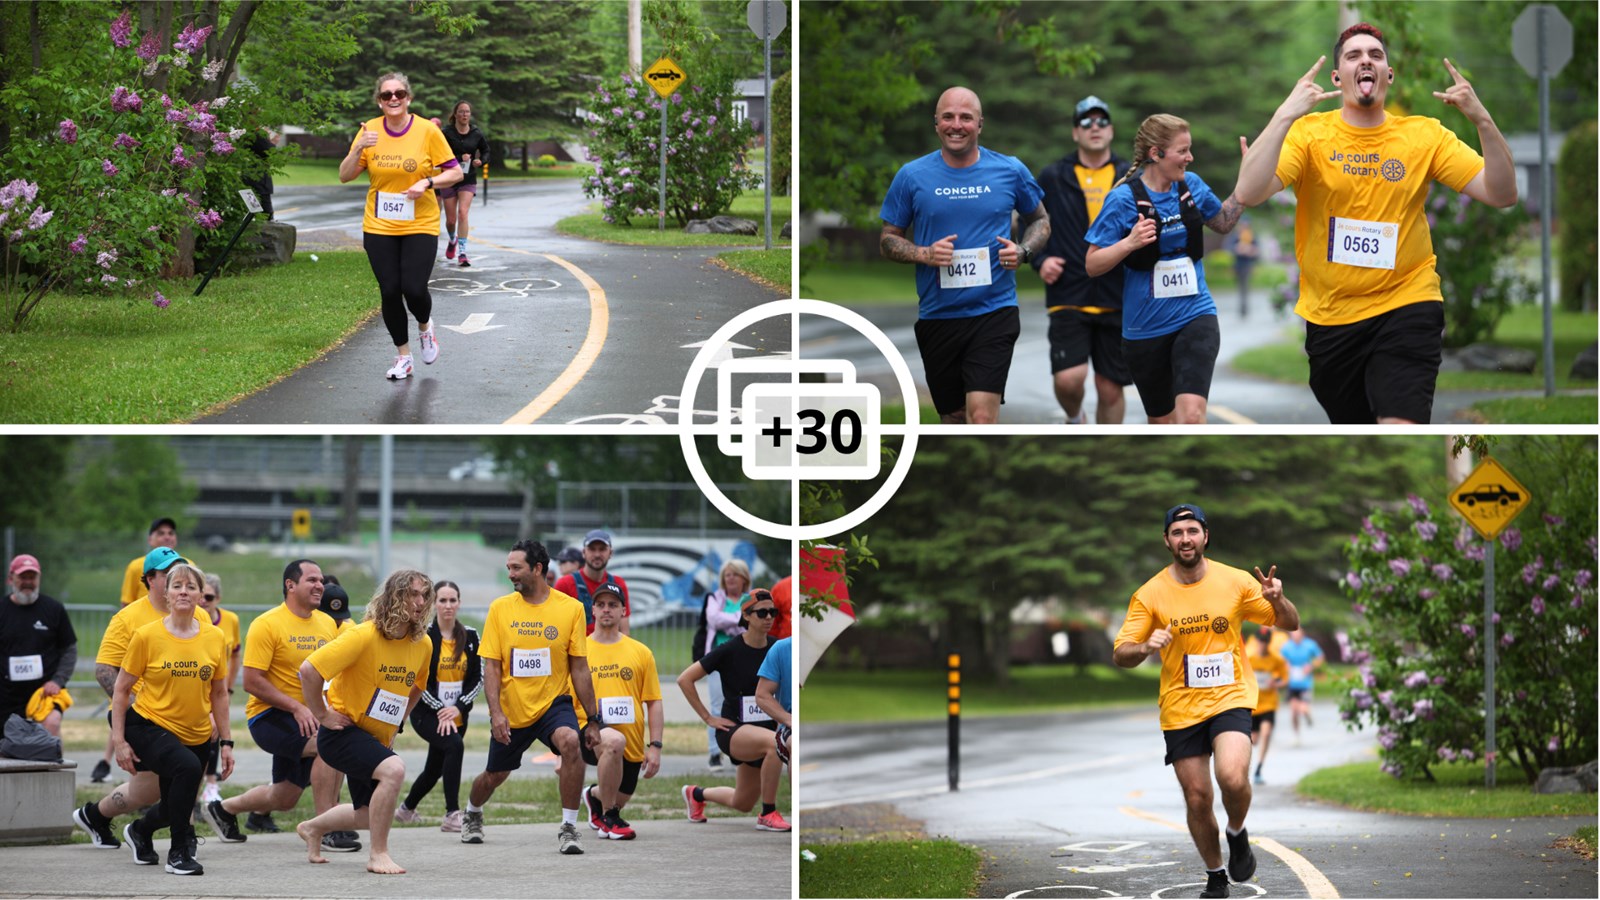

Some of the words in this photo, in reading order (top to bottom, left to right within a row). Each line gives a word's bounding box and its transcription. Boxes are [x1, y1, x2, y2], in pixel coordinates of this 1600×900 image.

[371, 153, 380, 161] Je
[1330, 150, 1344, 162] Je
[1347, 152, 1380, 163] cours
[1343, 164, 1378, 177] Rotary
[934, 185, 991, 196] CONCREA
[383, 202, 404, 212] 0547
[1361, 226, 1381, 235] Rotary
[1343, 235, 1379, 254] 0563
[948, 263, 976, 277] 0412
[1162, 272, 1189, 287] 0411
[511, 620, 519, 628] Je
[1181, 614, 1209, 625] cours
[518, 629, 542, 637] Rotary
[1179, 625, 1209, 635] Rotary
[161, 660, 172, 670] Je
[173, 660, 198, 669] cours
[378, 663, 388, 673] Je
[388, 665, 407, 673] cours
[518, 658, 541, 669] 0498
[599, 663, 619, 671] cours
[171, 669, 197, 678] Rotary
[597, 671, 619, 679] Rotary
[1196, 665, 1220, 678] 0511
[385, 674, 405, 683] Rotary
[379, 701, 400, 716] 0420
[608, 706, 628, 716] 0423
